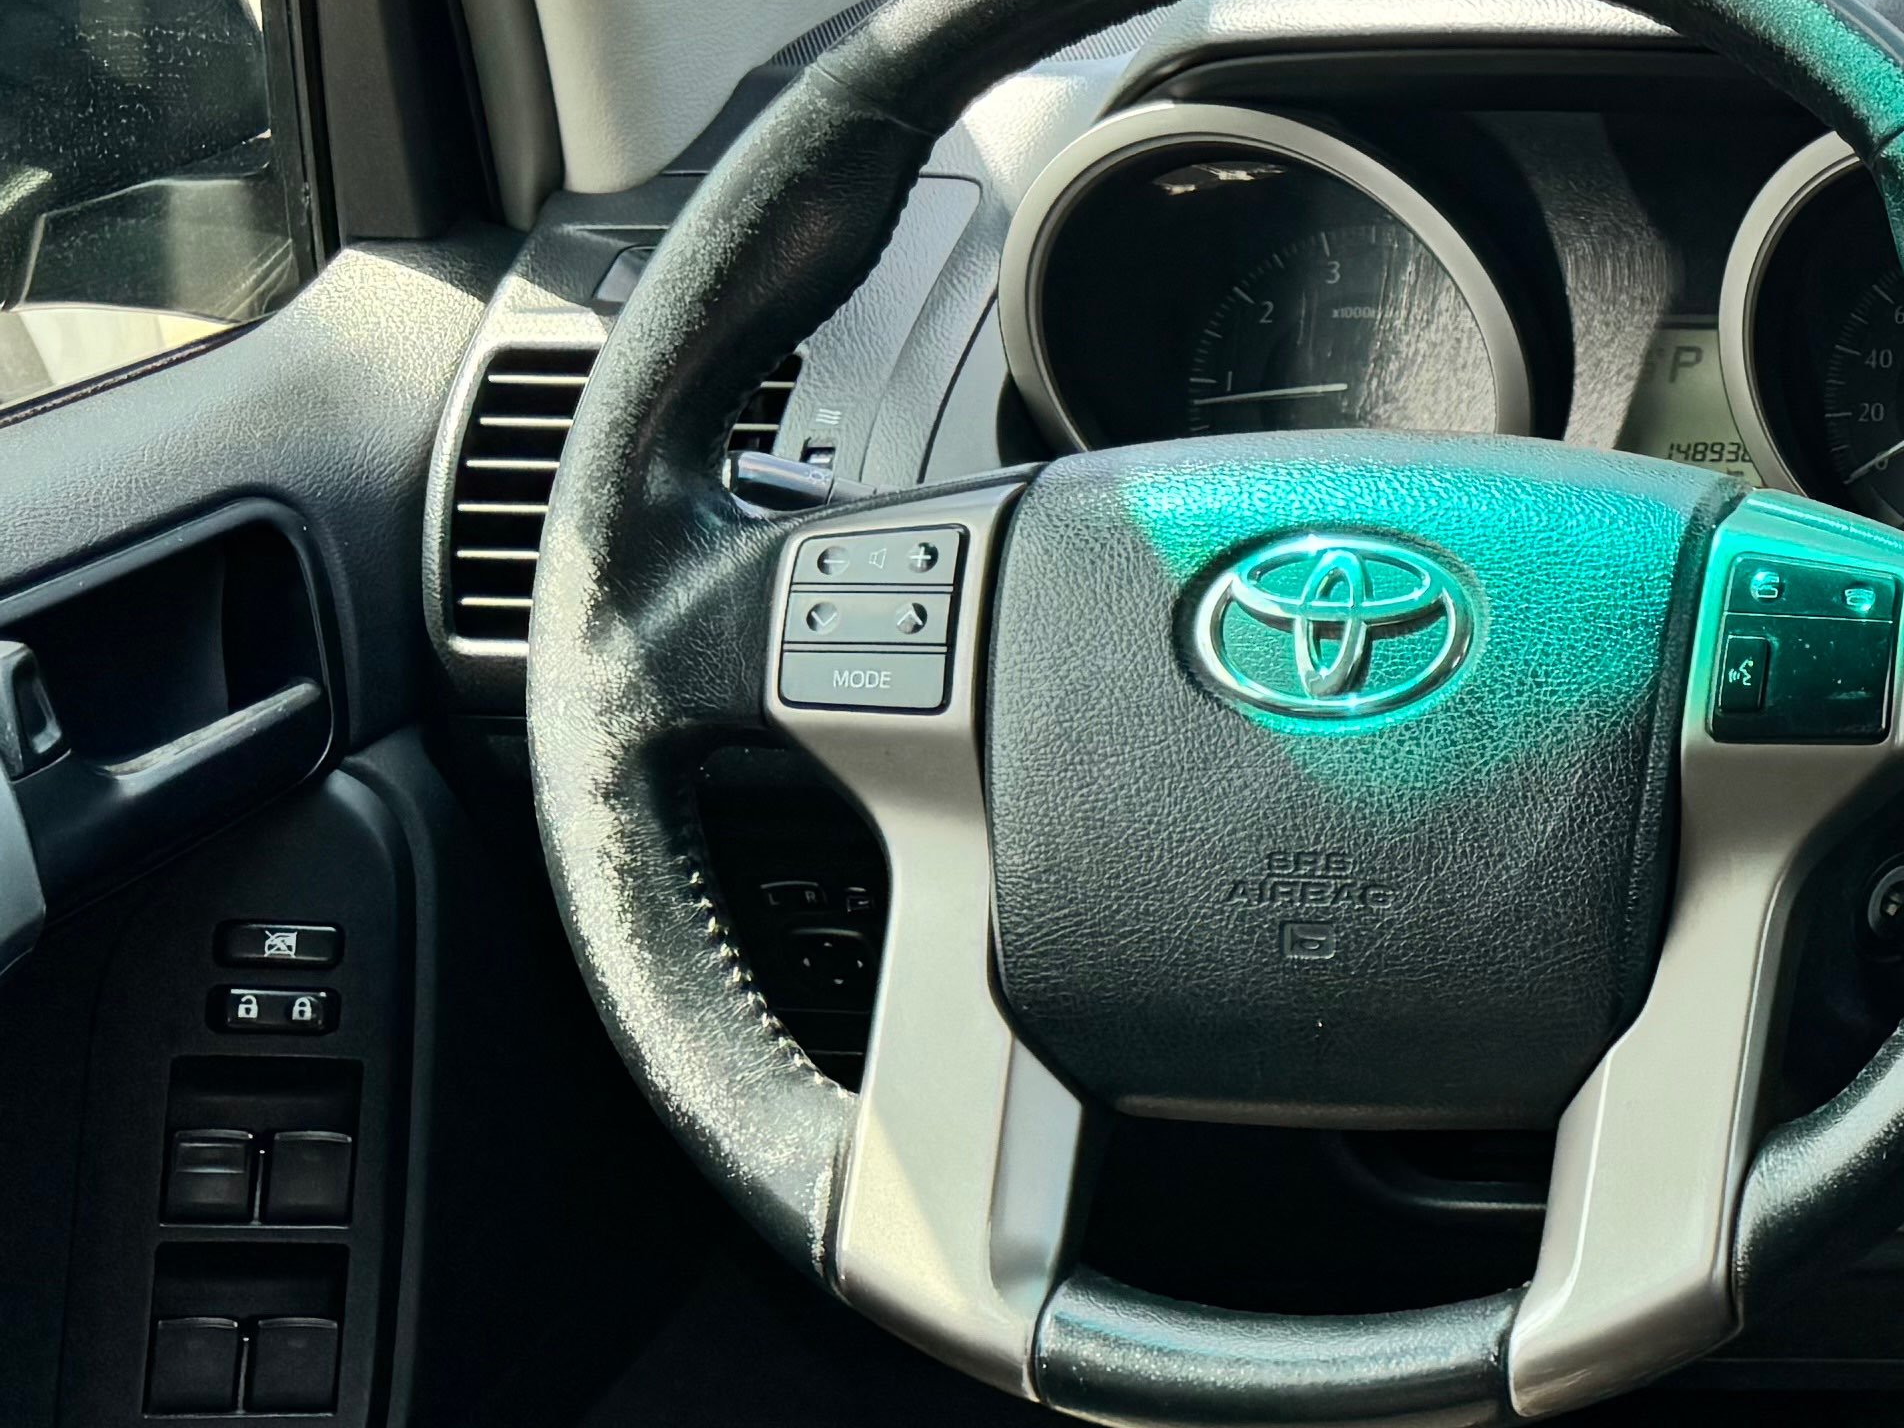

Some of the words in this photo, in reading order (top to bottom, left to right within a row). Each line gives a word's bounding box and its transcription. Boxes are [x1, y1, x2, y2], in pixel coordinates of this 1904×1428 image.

[1326, 261, 1341, 284] 3
[1260, 301, 1274, 324] 2
[1669, 346, 1704, 383] P
[1864, 349, 1893, 369] 40
[1858, 403, 1884, 422] 20
[833, 670, 892, 688] MODE
[1227, 880, 1398, 909] AIRBAG
